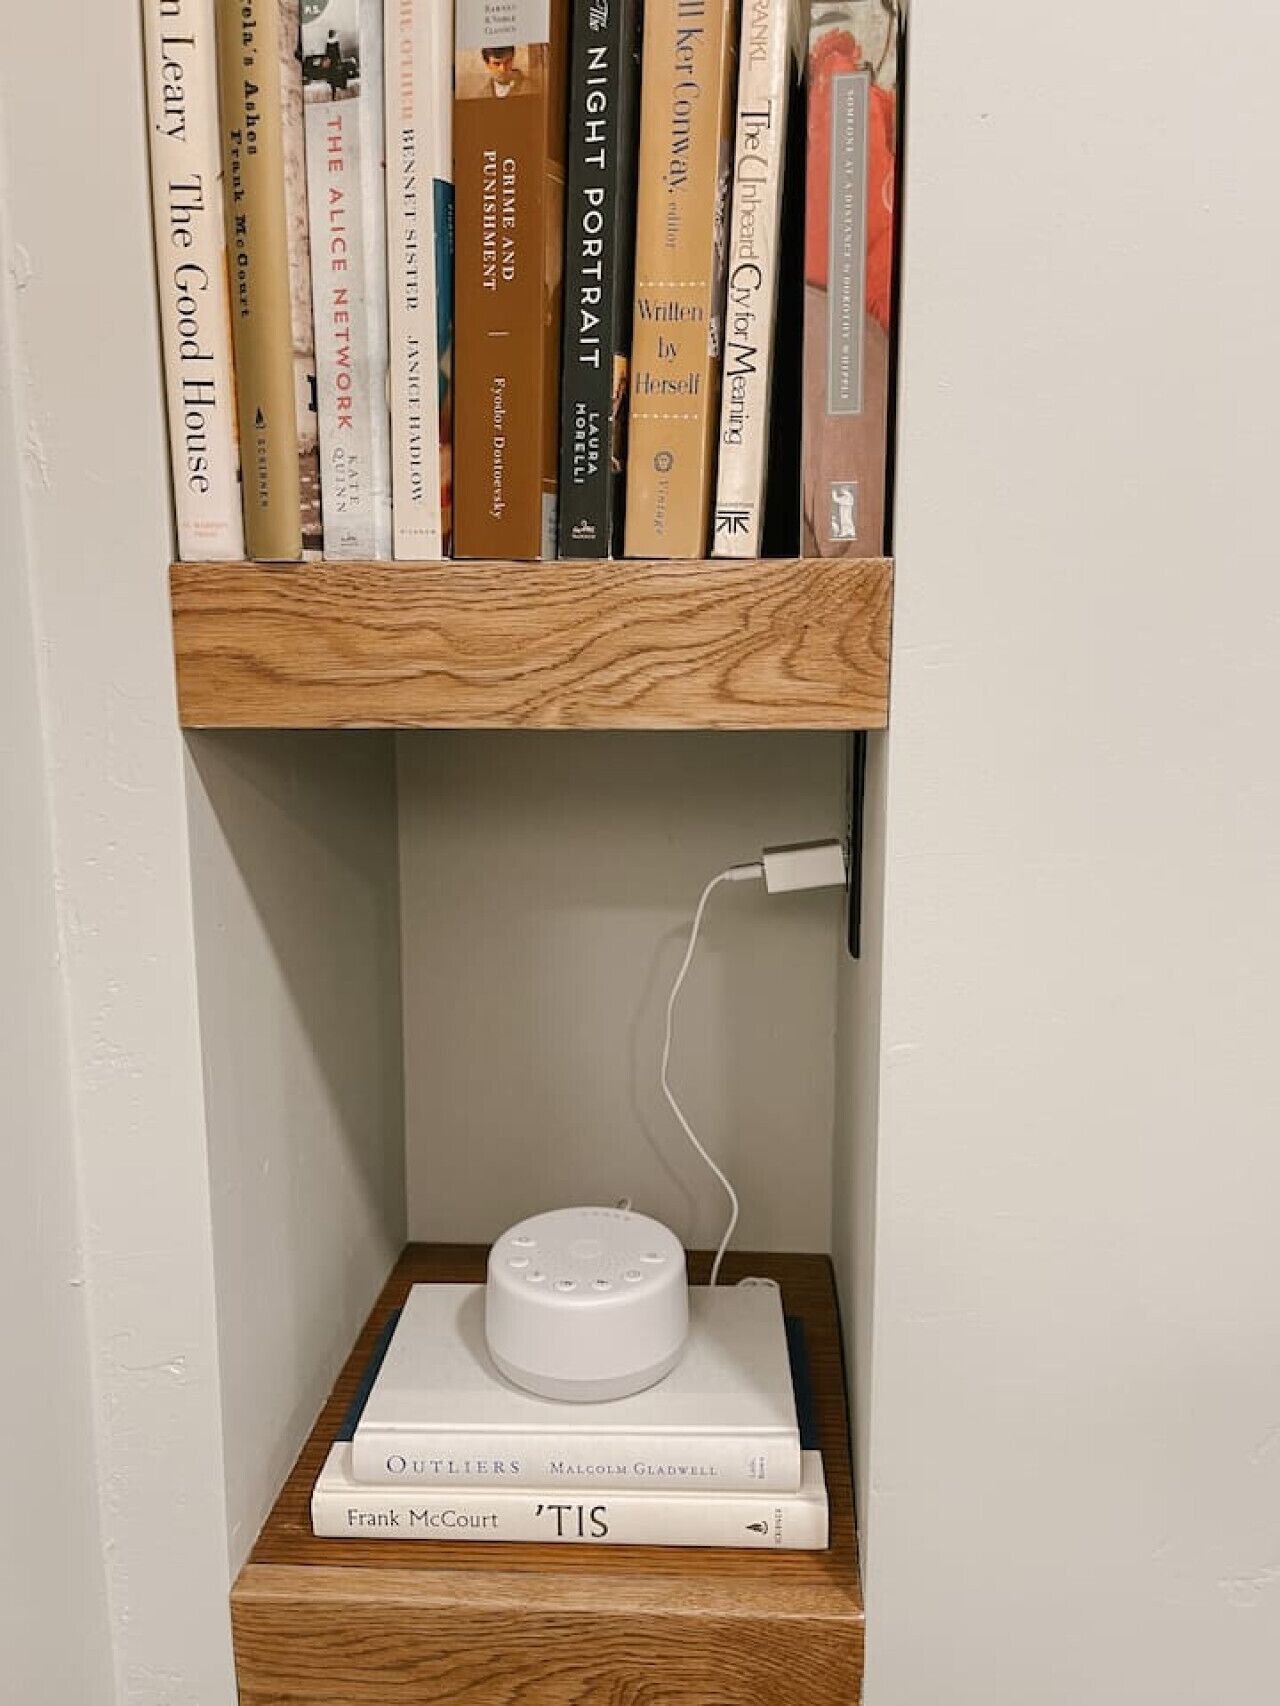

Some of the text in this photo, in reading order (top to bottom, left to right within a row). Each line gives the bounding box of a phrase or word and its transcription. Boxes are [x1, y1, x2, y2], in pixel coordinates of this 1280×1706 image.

[156, 34, 195, 143] Leary
[241, 0, 261, 155] ela's Ashes
[400, 38, 414, 120] OTHER
[675, 27, 705, 76] Ker
[583, 46, 609, 169] NIGHT
[740, 99, 772, 150] The
[230, 129, 246, 202] Frank
[401, 129, 416, 221] BENNET
[168, 174, 205, 249] The
[482, 150, 498, 291] PUNISHMENT
[502, 158, 517, 282] CRIME AND
[665, 202, 681, 248] editor
[736, 154, 768, 259] Unheard
[326, 115, 354, 429] THE ALICE NETWORK
[404, 229, 418, 312] SISTER
[578, 187, 606, 370] PORTRAIT
[728, 262, 762, 308] Cry
[173, 264, 215, 362] Good
[637, 298, 703, 323] Written
[657, 335, 678, 363] by
[734, 311, 757, 342] for
[407, 334, 420, 411] JANICE
[489, 377, 506, 430] Fyodor
[634, 372, 701, 396] Herself
[723, 342, 758, 446] Meaning
[182, 376, 216, 495] House
[408, 416, 424, 503] HADLOW
[572, 402, 587, 485] MORELLI
[586, 412, 600, 474] LAURA
[332, 447, 347, 513] QUINN
[347, 455, 361, 506] KATE
[385, 1454, 720, 1477] OUTLIERS MALCOLM GLADWELL
[347, 1508, 400, 1529] Frank
[408, 1508, 499, 1529] McCourt
